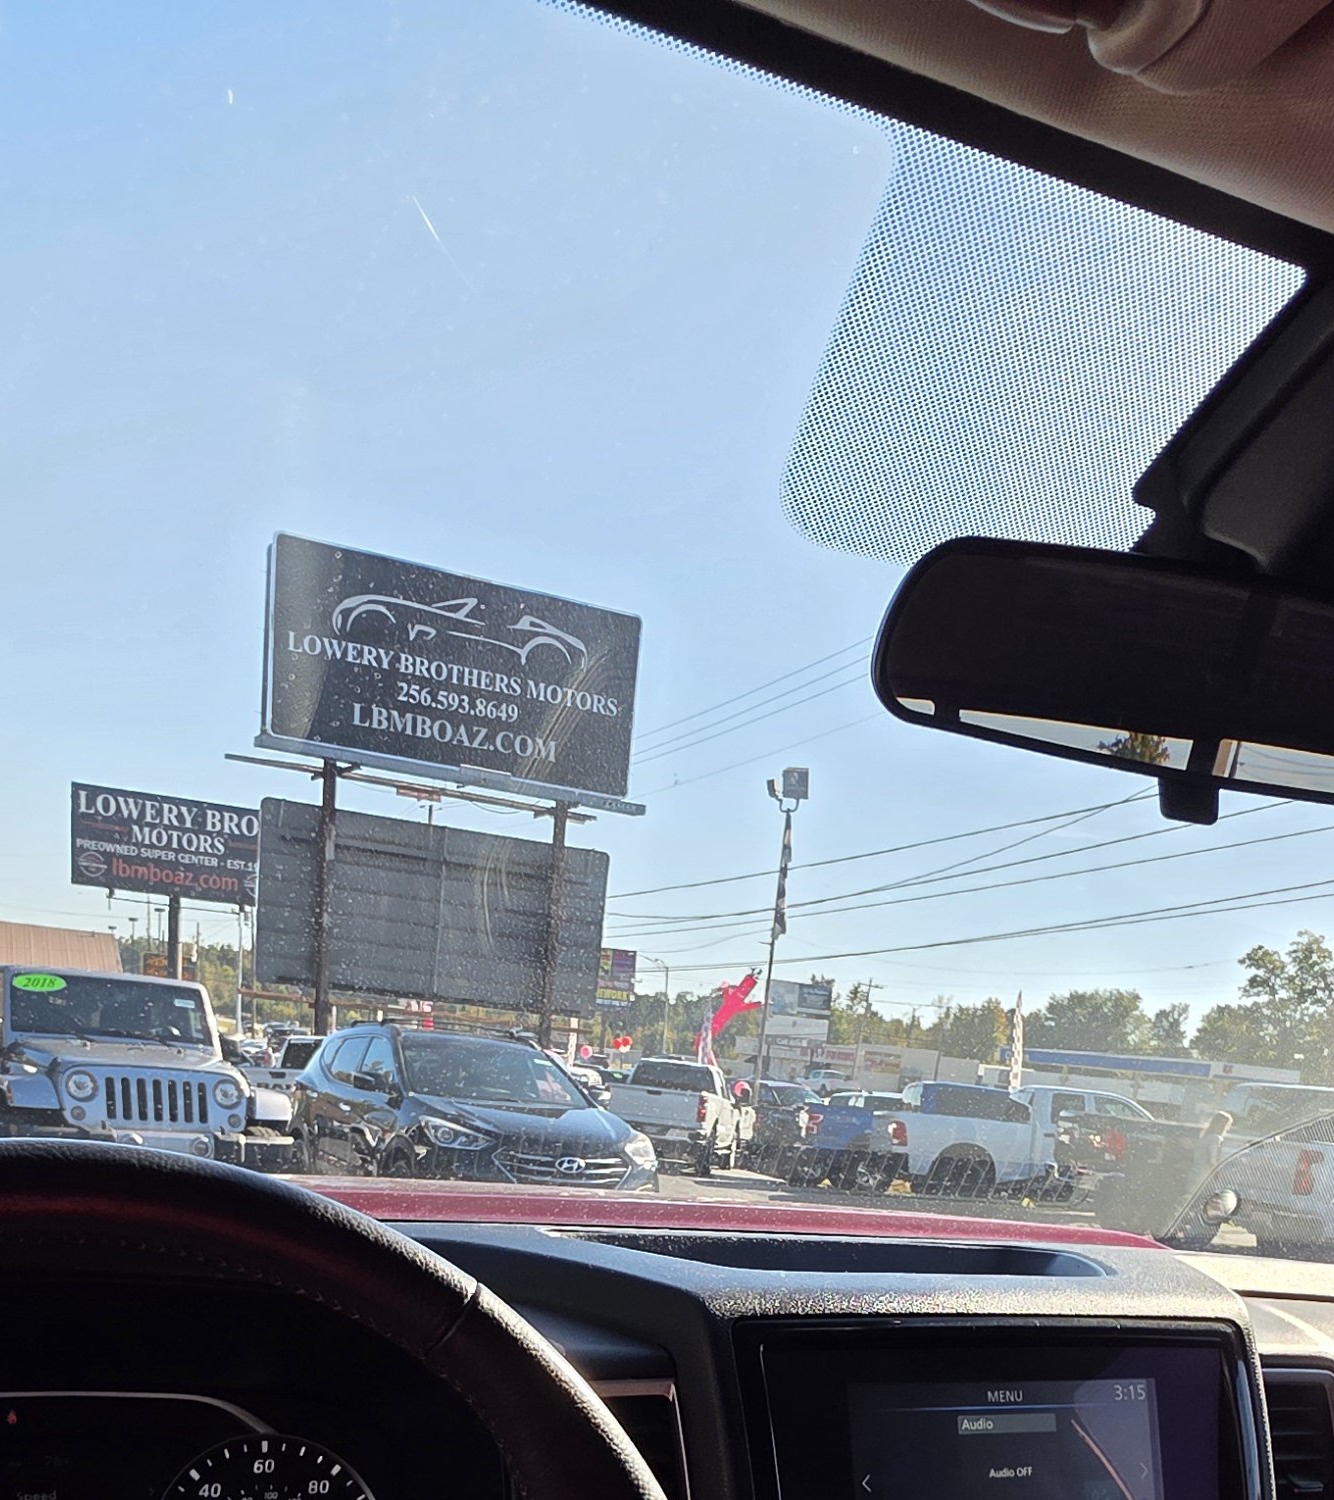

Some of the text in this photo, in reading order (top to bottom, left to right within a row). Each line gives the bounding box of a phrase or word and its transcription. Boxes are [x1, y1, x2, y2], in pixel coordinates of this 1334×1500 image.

[287, 631, 618, 717] LOWERY BROTHERS MOTORS
[397, 682, 518, 723] 256.593.8649
[353, 702, 558, 763] LBMBOAZ.COM
[78, 790, 198, 829] LOWERY
[76, 838, 138, 856] PREOWNED
[140, 847, 176, 861] SUPER
[177, 853, 218, 867] CENTER
[131, 824, 225, 855] MOTORS
[111, 857, 239, 891] lbmboaz.com
[987, 1384, 1147, 1403] MENU 3:15
[961, 1418, 994, 1431] Audio
[253, 1459, 275, 1474] 60
[989, 1466, 1033, 1479] Audio OFF
[198, 1482, 222, 1498] 40
[308, 1480, 330, 1495] 80
